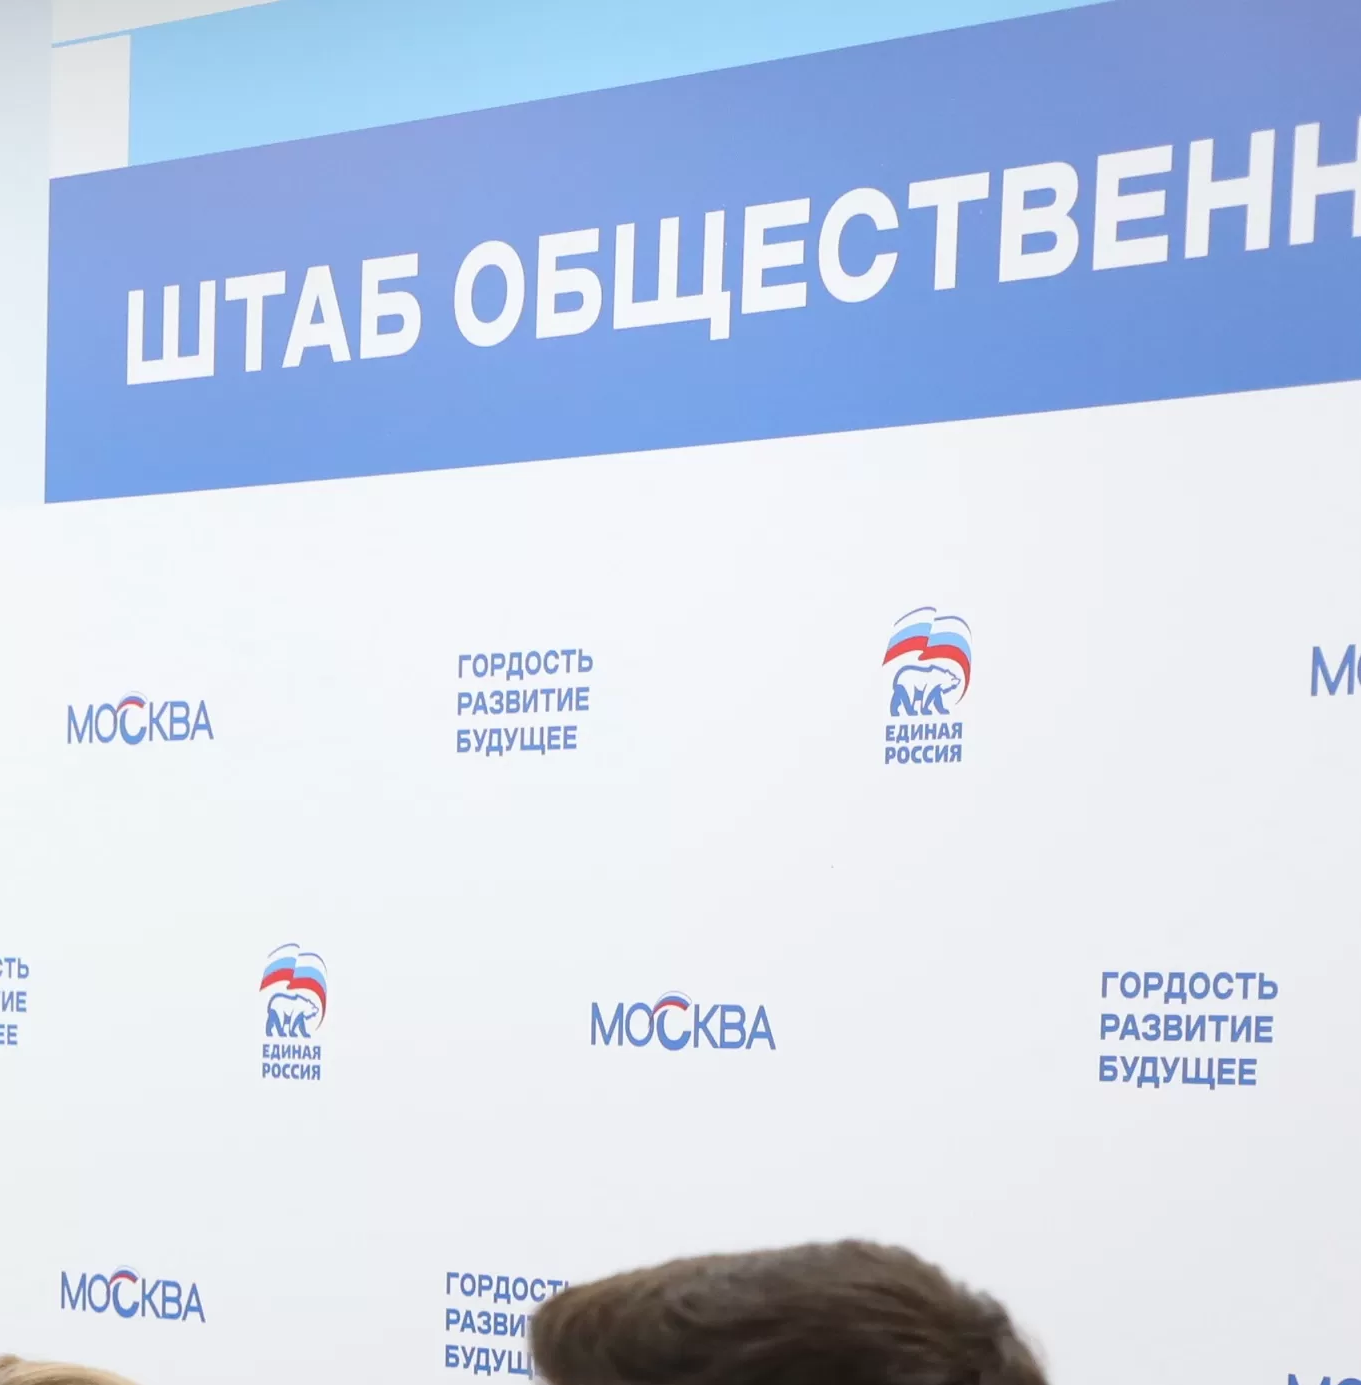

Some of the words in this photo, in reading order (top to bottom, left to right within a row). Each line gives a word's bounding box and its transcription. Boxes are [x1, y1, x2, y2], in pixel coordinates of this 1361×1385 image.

[125, 250, 424, 387] ШТАБ
[452, 115, 1361, 348] ОБЩЕСТВЕНН
[457, 648, 594, 678] ГОРДОСТЬ
[457, 686, 591, 716] РАЗВИТИЕ
[67, 693, 214, 745] МОСКВА
[884, 722, 964, 744] ЕДИНАЯ
[455, 724, 578, 754] БУДУЩЕЕ
[884, 743, 963, 765] РОССИЯ
[1101, 970, 1280, 1001] ГОРДОСТЬ
[590, 991, 777, 1052] МОСКВА
[1100, 1013, 1275, 1043] РАЗВИТИЕ
[261, 1043, 323, 1060] ЕДИНАЯ
[261, 1061, 322, 1080] РОССИЯ
[1098, 1055, 1257, 1088] БУДУЩЕЕ
[60, 1266, 205, 1321] МОСКВА
[445, 1271, 570, 1304] ГОРДОСТ
[444, 1307, 535, 1338] РАЗВИ
[444, 1344, 535, 1380] БУДУЩ
